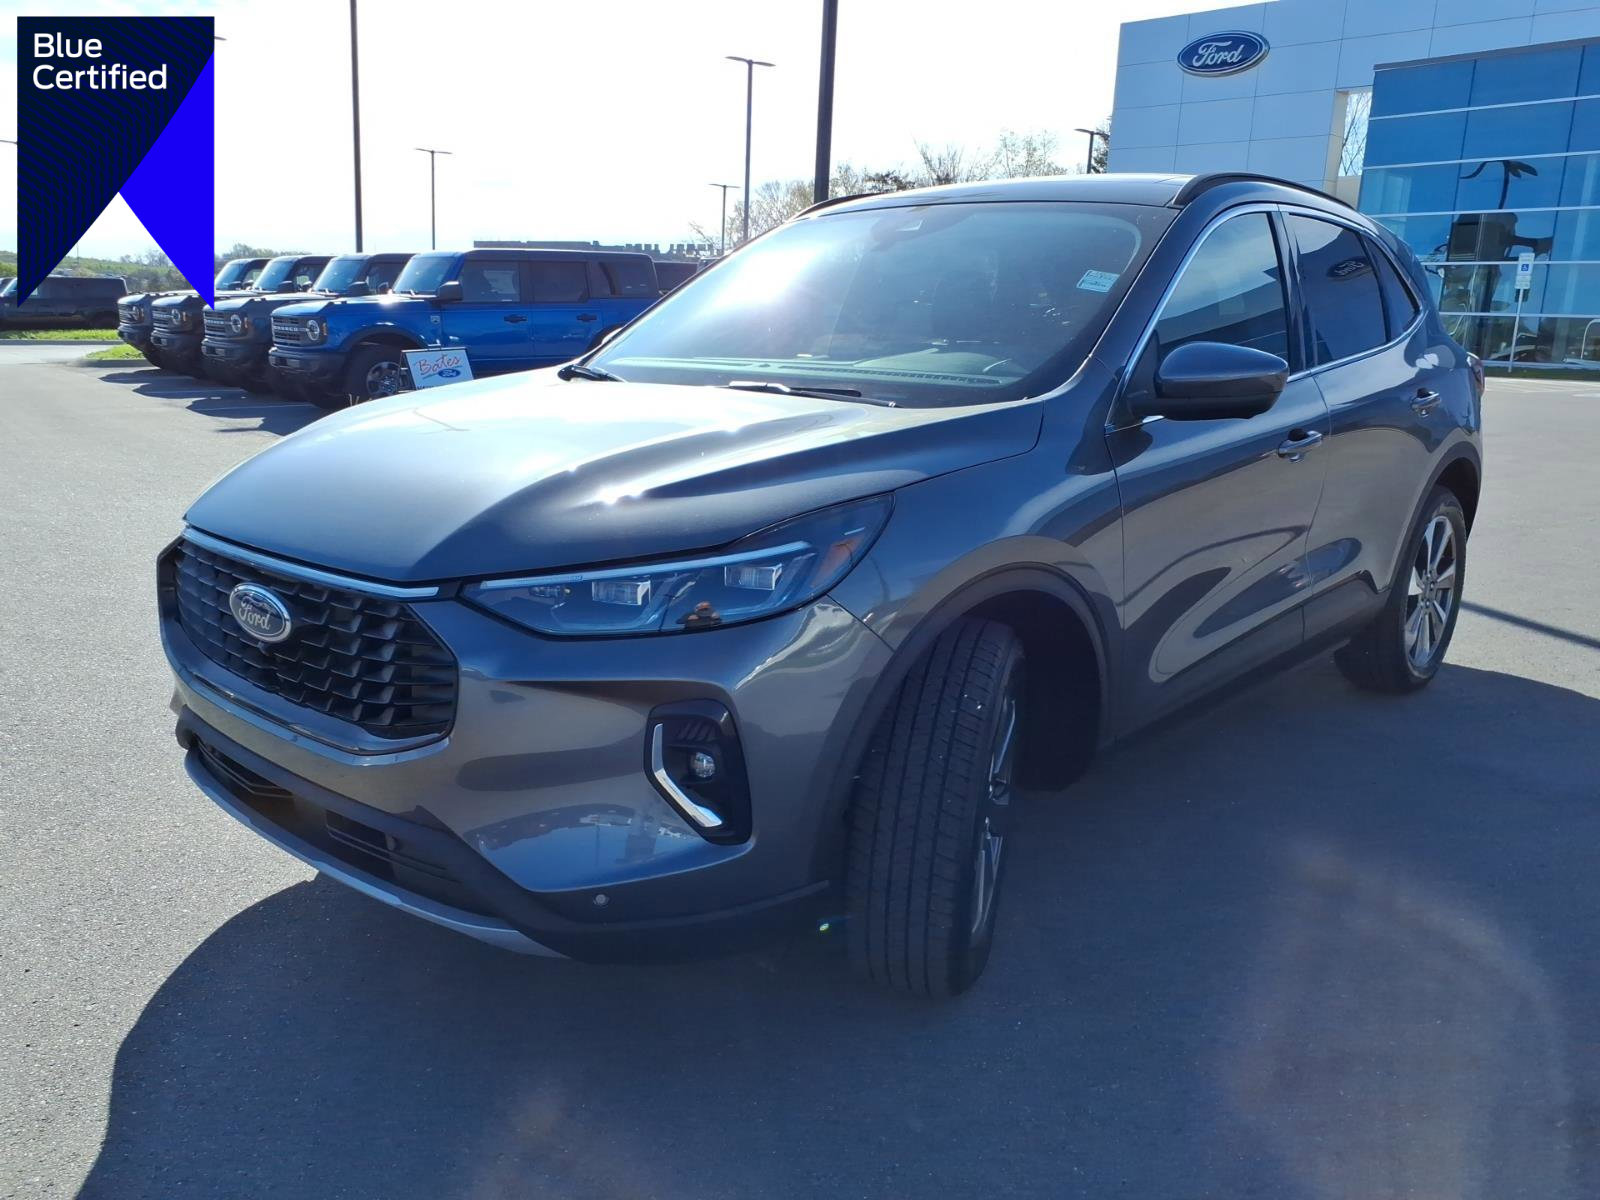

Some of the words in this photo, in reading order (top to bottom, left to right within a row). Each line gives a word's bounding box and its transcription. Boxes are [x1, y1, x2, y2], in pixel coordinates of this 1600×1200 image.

[1192, 41, 1245, 67] Ford
[415, 354, 460, 375] Bates
[238, 595, 272, 630] Ford
